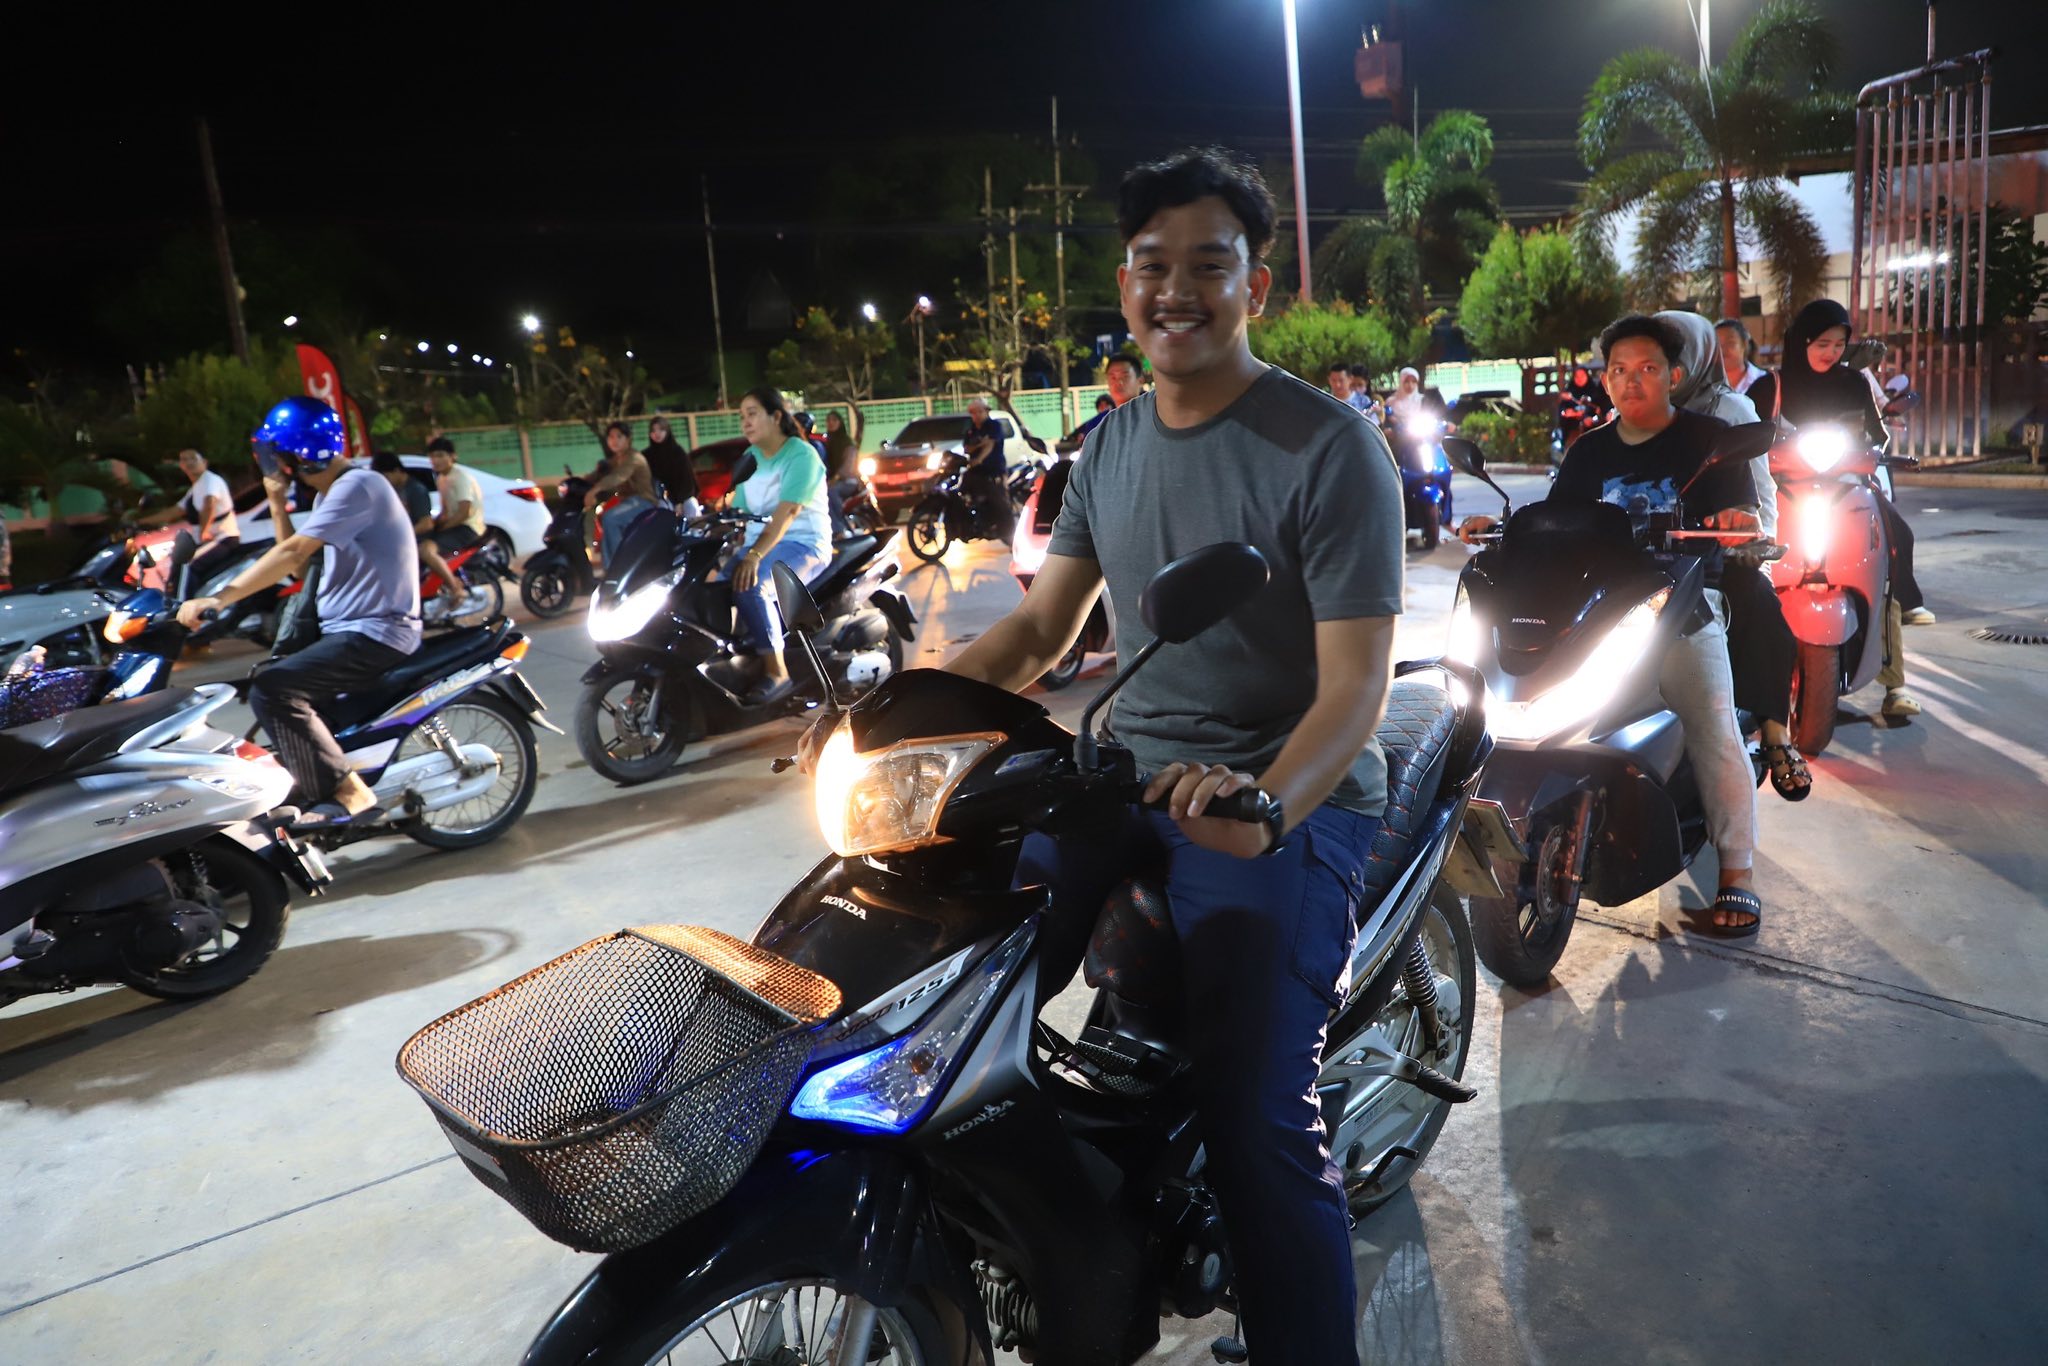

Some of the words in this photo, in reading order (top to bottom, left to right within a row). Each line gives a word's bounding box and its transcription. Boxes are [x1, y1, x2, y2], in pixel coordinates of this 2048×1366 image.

[820, 895, 867, 920] HONDA
[1716, 895, 1760, 909] ALENCIAGA
[943, 1100, 1016, 1140] HONDA
